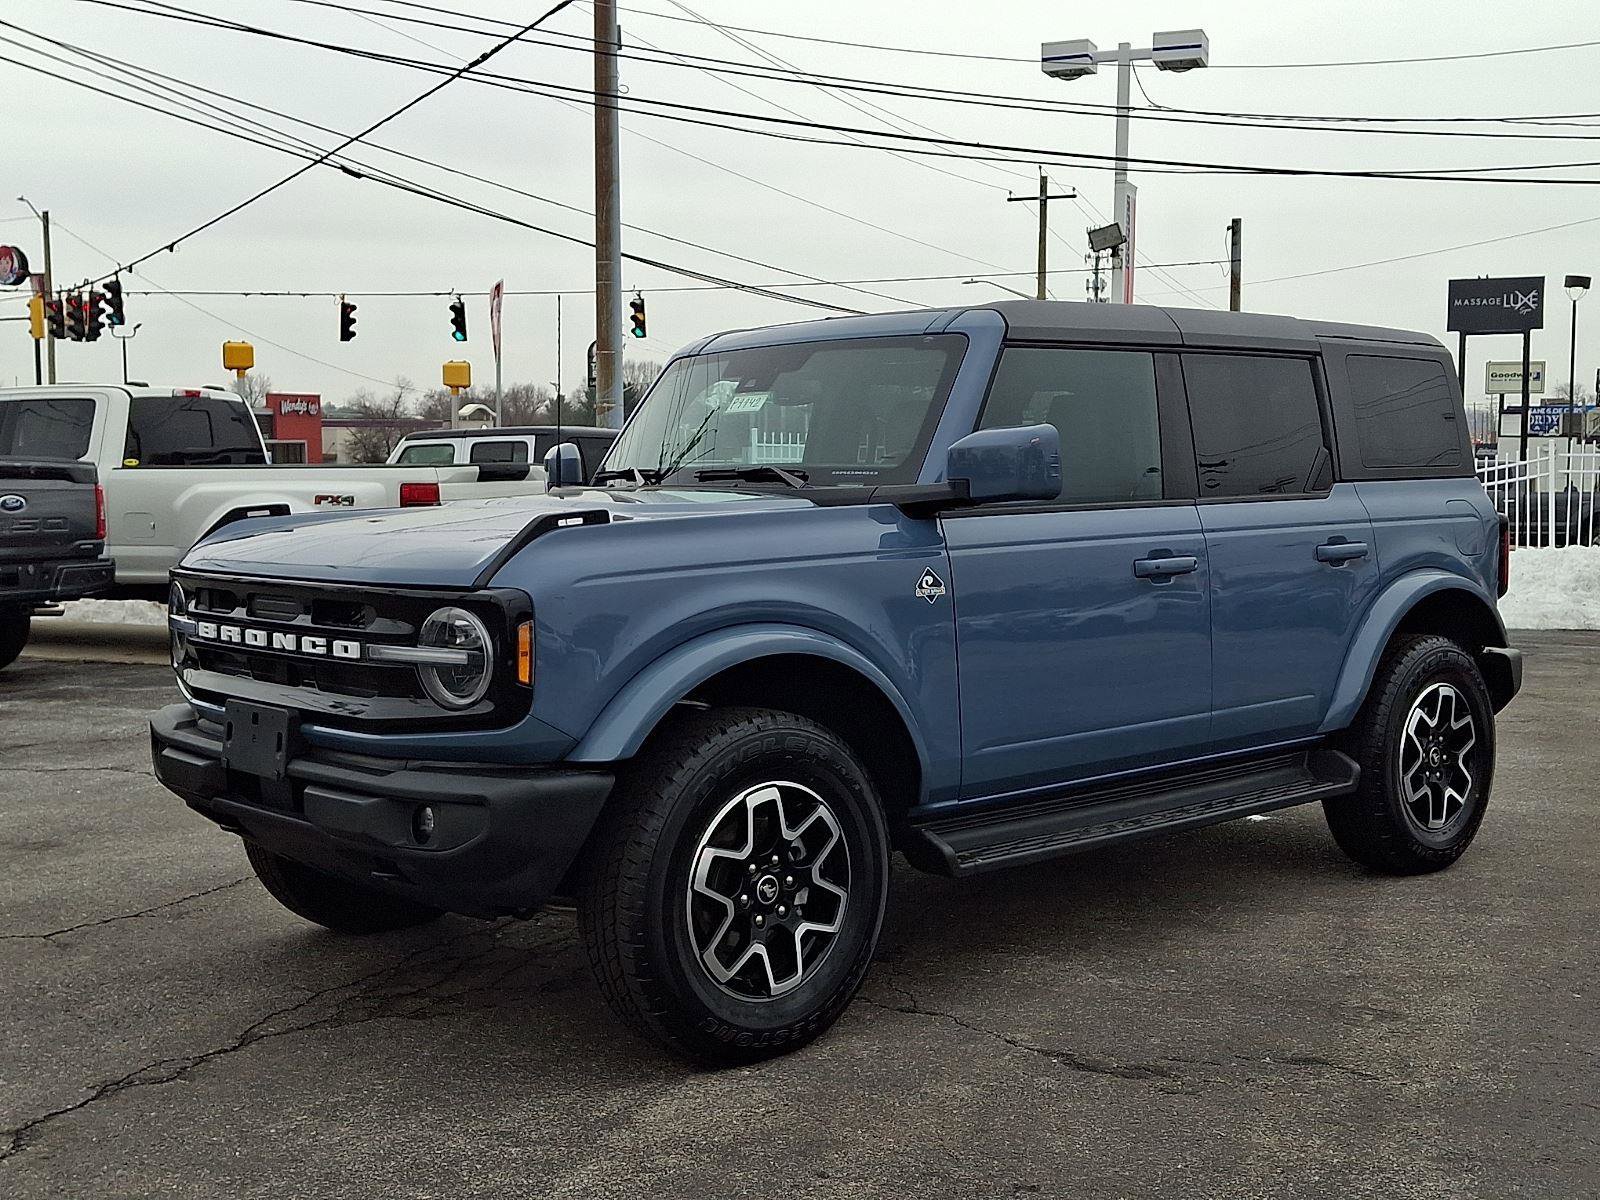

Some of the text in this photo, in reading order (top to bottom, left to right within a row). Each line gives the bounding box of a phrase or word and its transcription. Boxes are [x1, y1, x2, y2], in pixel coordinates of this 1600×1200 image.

[1454, 290, 1539, 310] MASSAGE LUXE
[314, 495, 355, 507] FX4
[197, 620, 362, 661] BRONCO
